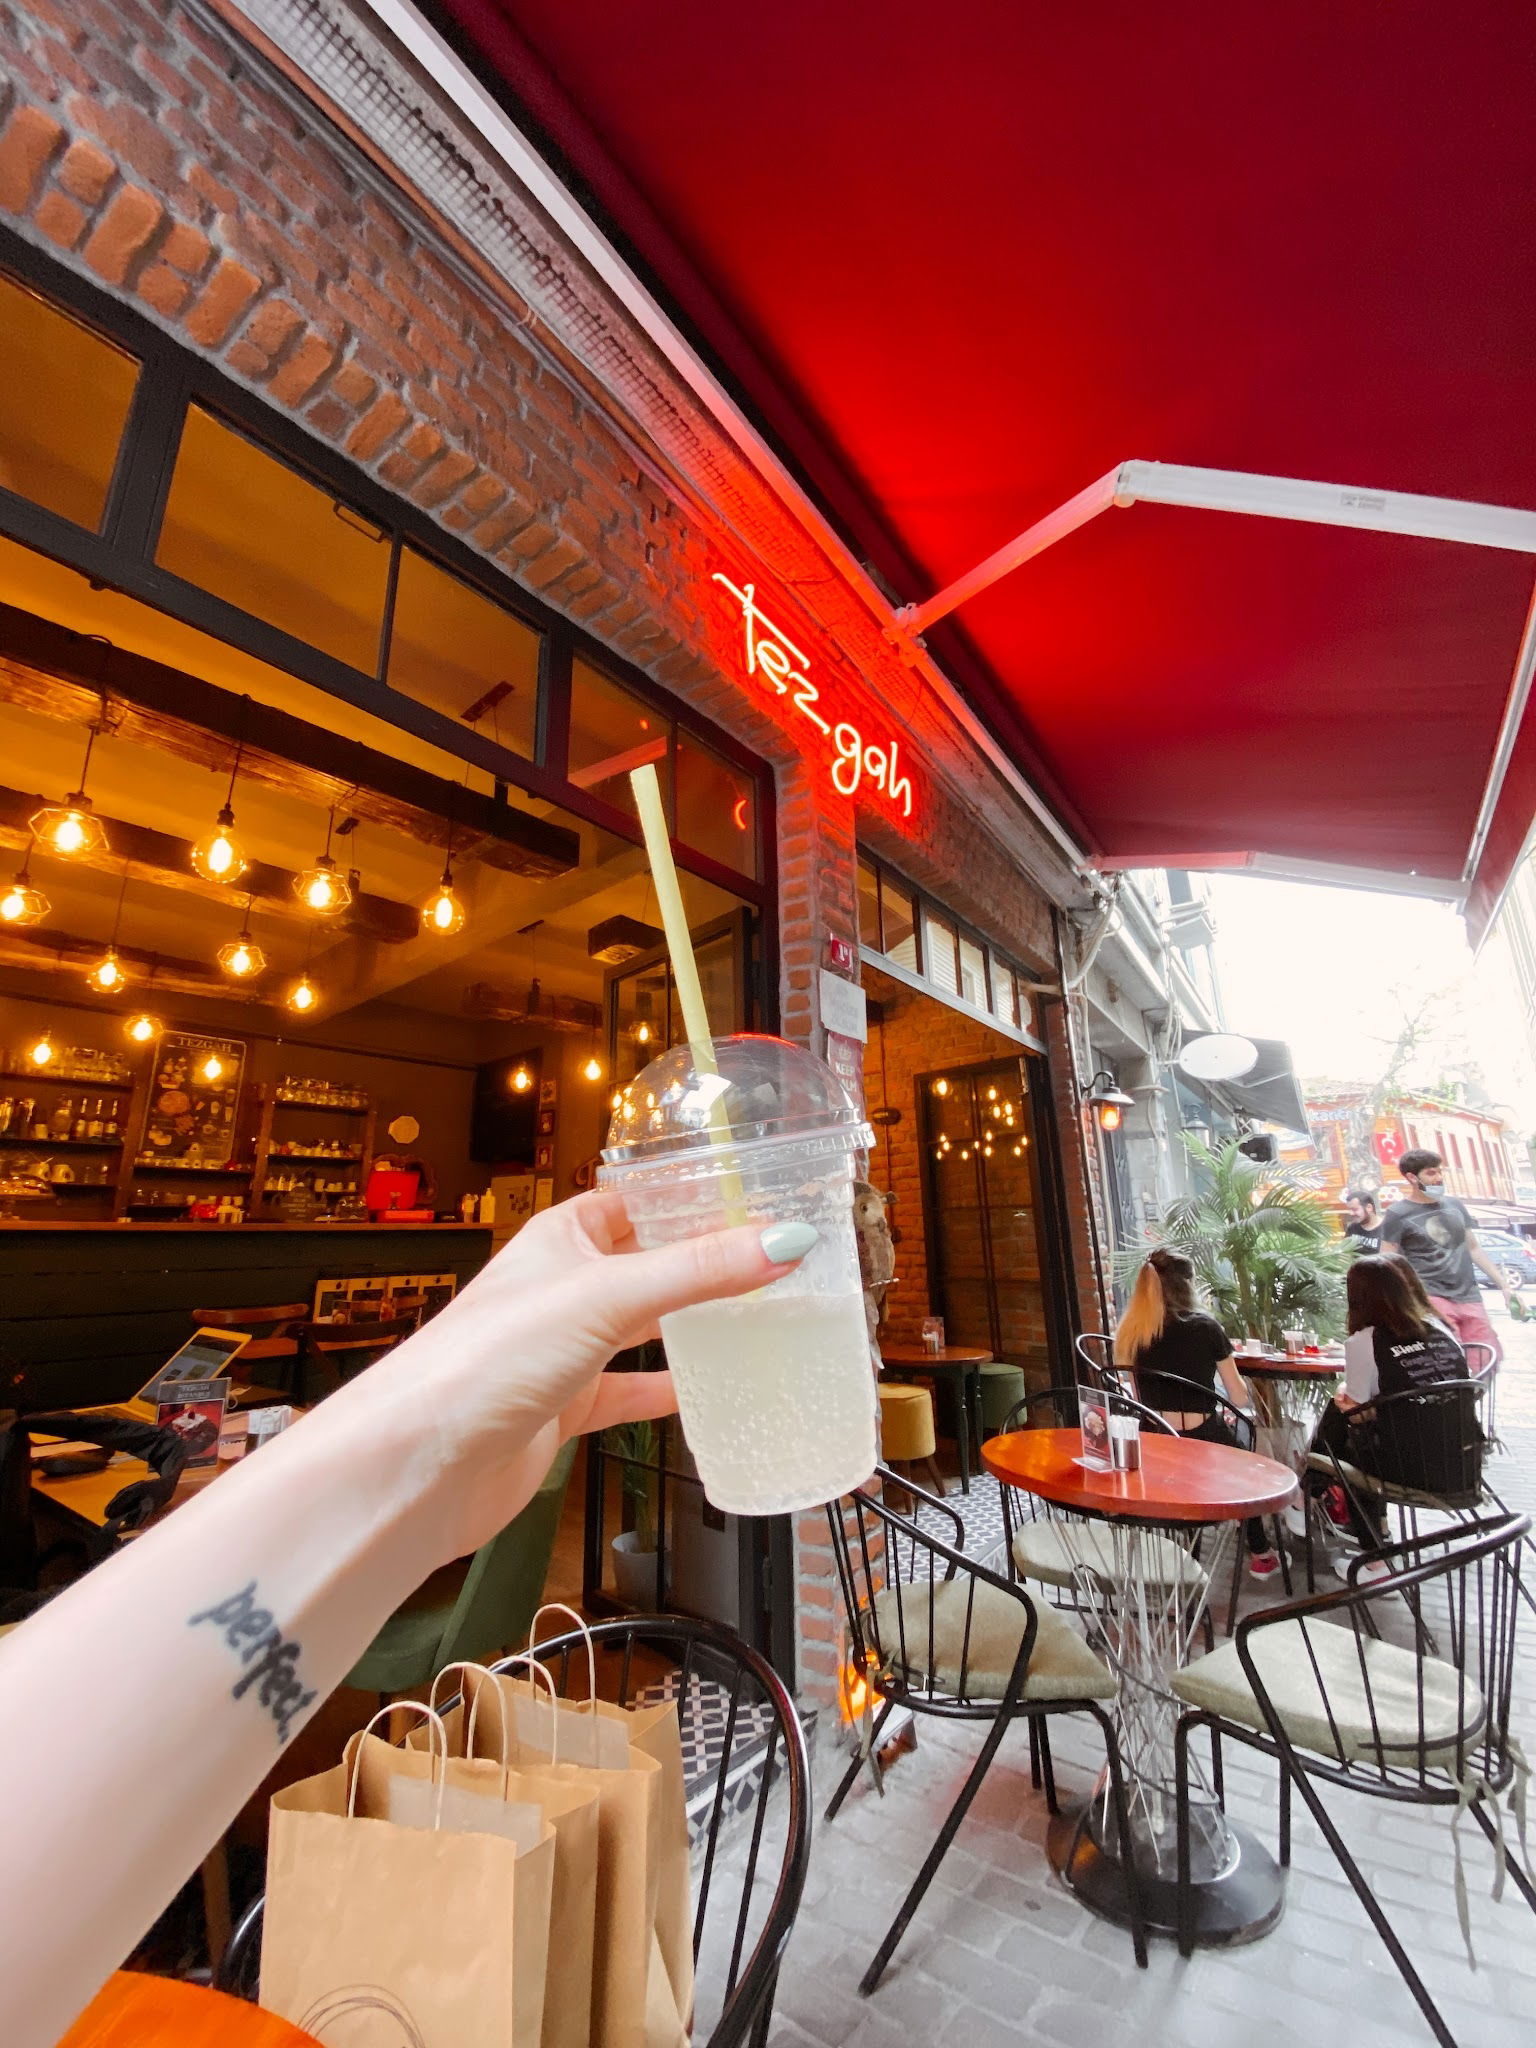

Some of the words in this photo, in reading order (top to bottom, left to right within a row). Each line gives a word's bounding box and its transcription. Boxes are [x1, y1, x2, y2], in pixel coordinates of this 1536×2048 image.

[835, 1061, 856, 1076] KEEP
[841, 1078, 857, 1092] ALM
[187, 1580, 318, 1745] perfect
